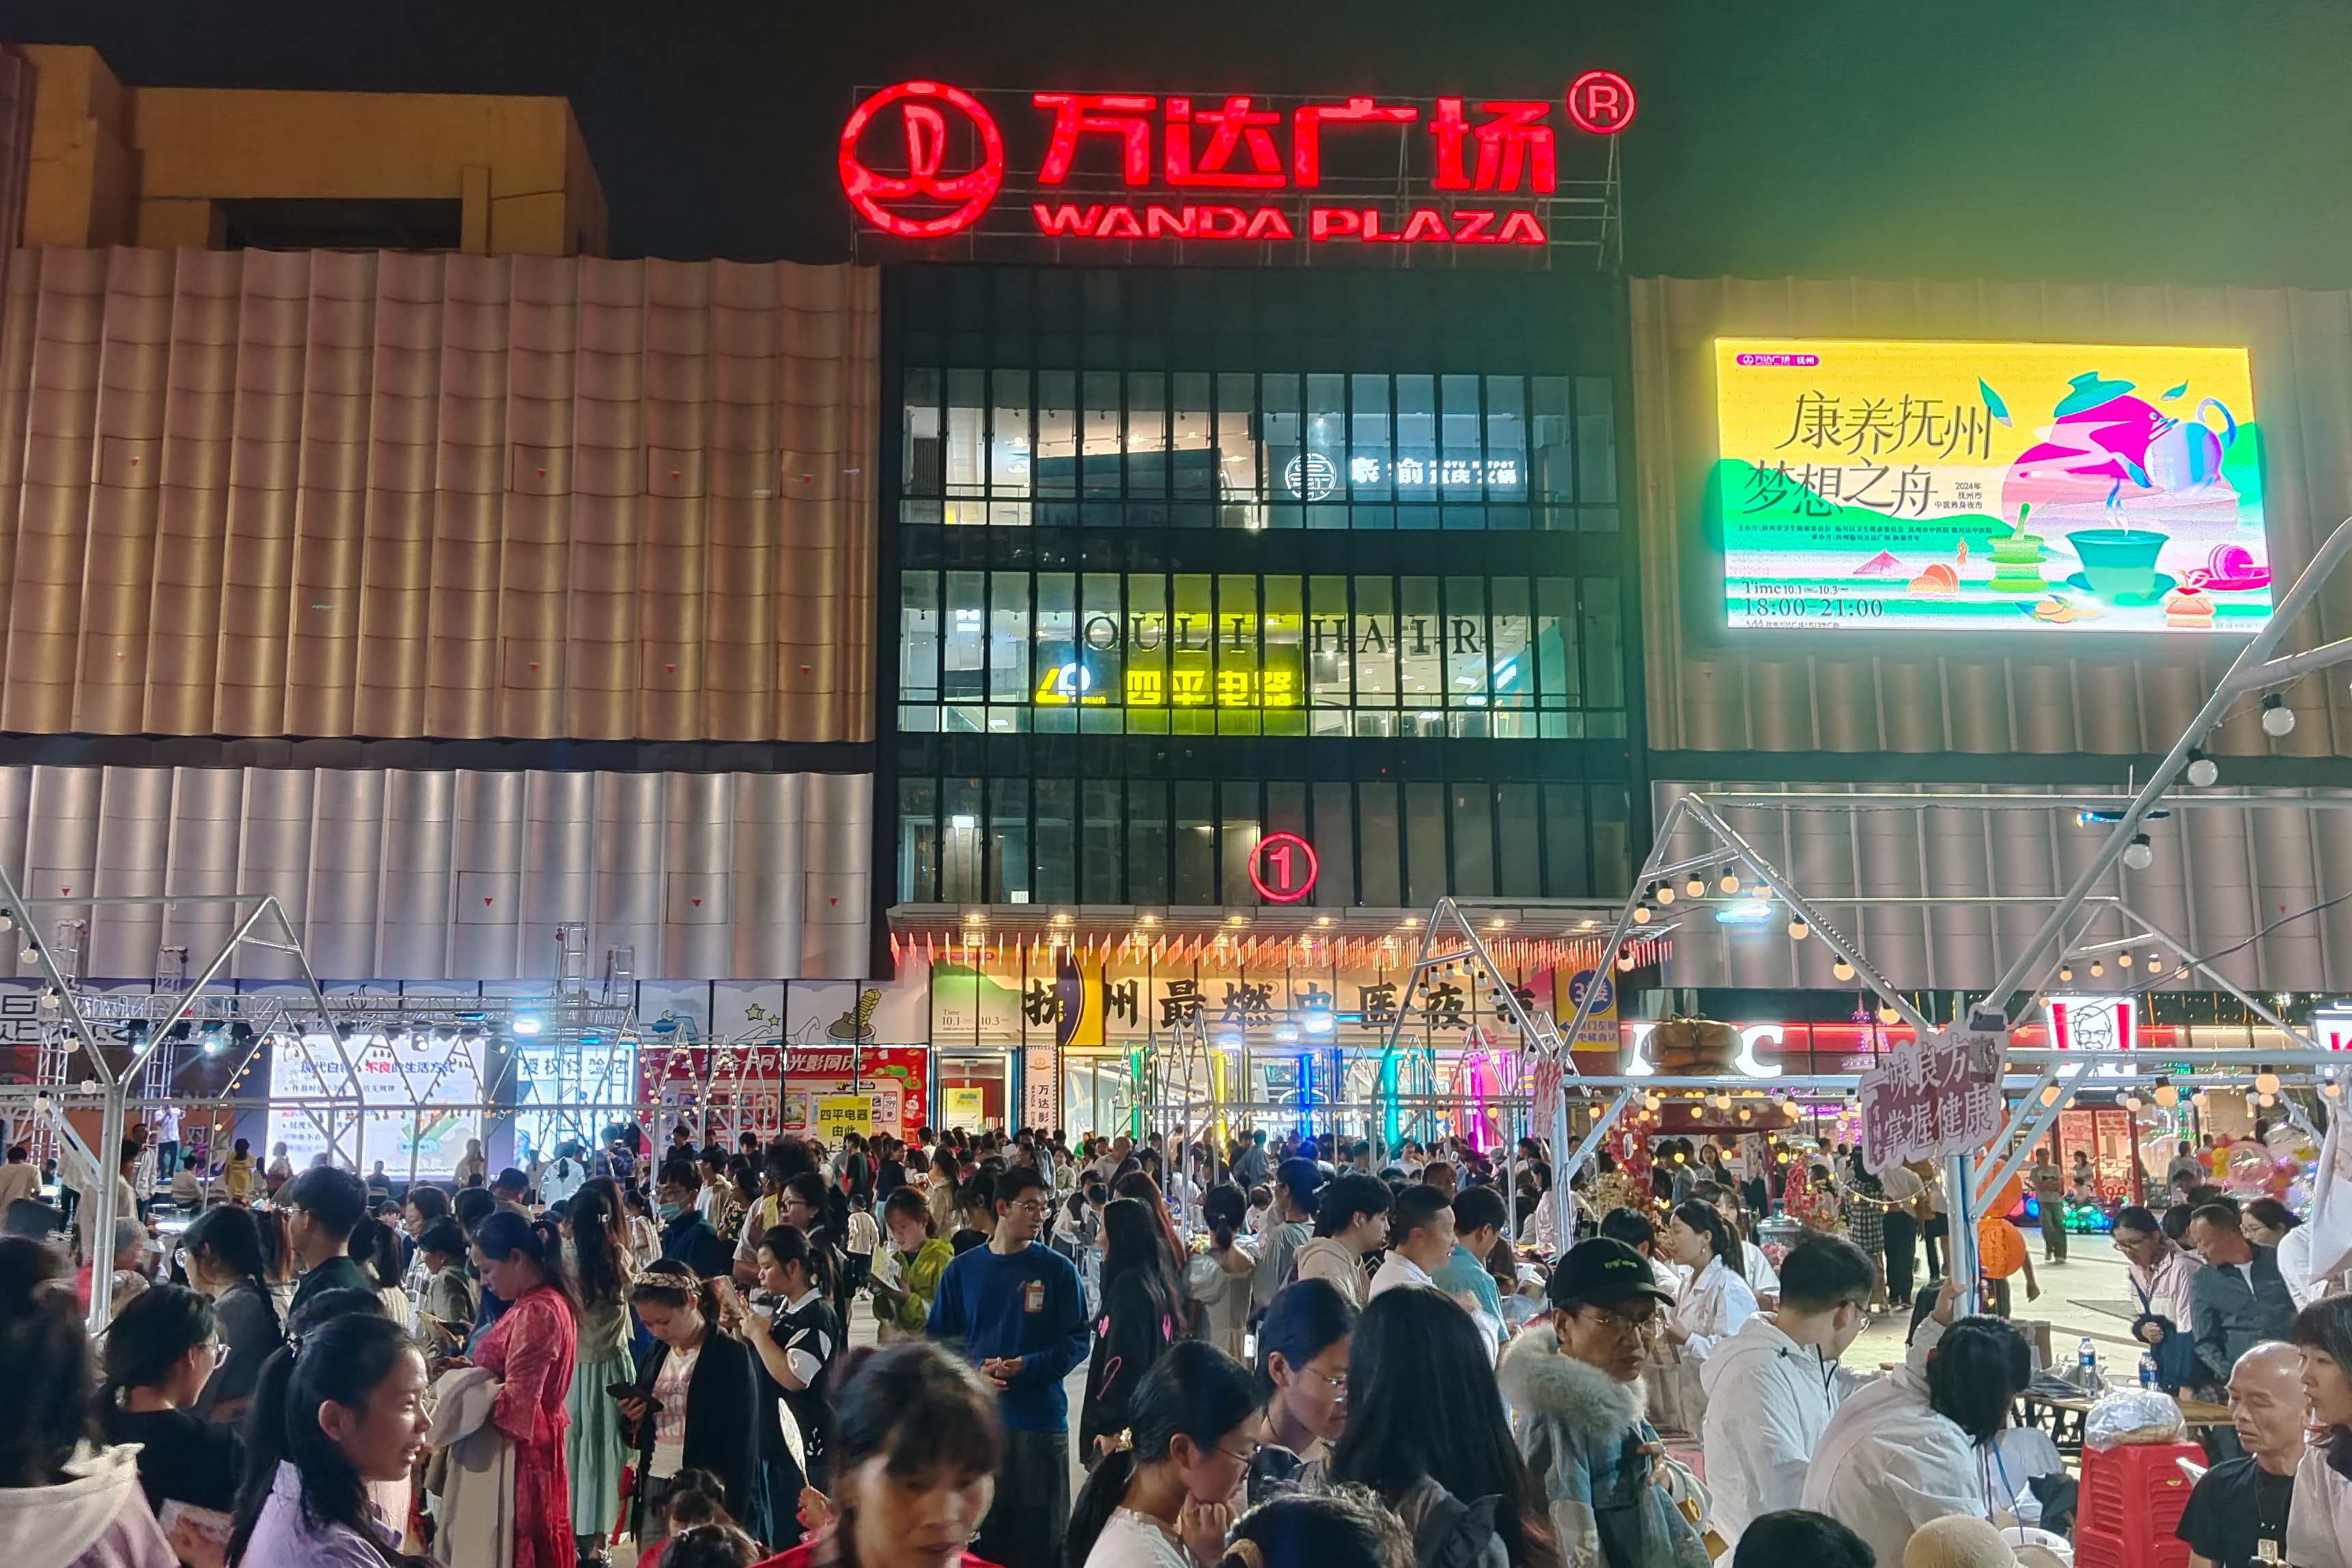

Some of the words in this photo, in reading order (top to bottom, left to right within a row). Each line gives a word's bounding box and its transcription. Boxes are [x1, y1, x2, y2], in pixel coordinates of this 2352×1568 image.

[1033, 94, 1556, 192] 万达广场
[1033, 206, 1293, 240] WANDA
[1312, 209, 1546, 244] PLAZA
[1774, 389, 1993, 460] 康养抚州
[1742, 457, 1939, 518] 梦想之舟
[1955, 481, 1982, 490] 2024年
[1743, 580, 1781, 594] Time
[1784, 585, 1802, 595] 10.1
[1819, 585, 1838, 595] 10.3
[1084, 616, 1246, 654] OULI
[1311, 617, 1484, 657] HAIR
[1128, 670, 1291, 705] 四平电器
[942, 1016, 961, 1026] 10.1
[981, 1016, 1000, 1026] 10.3
[1864, 1032, 1970, 1101] 一味良方
[820, 1108, 868, 1121] 四平电器
[1038, 1084, 1050, 1130] 万达影
[1884, 1083, 1993, 1158] 掌握健康
